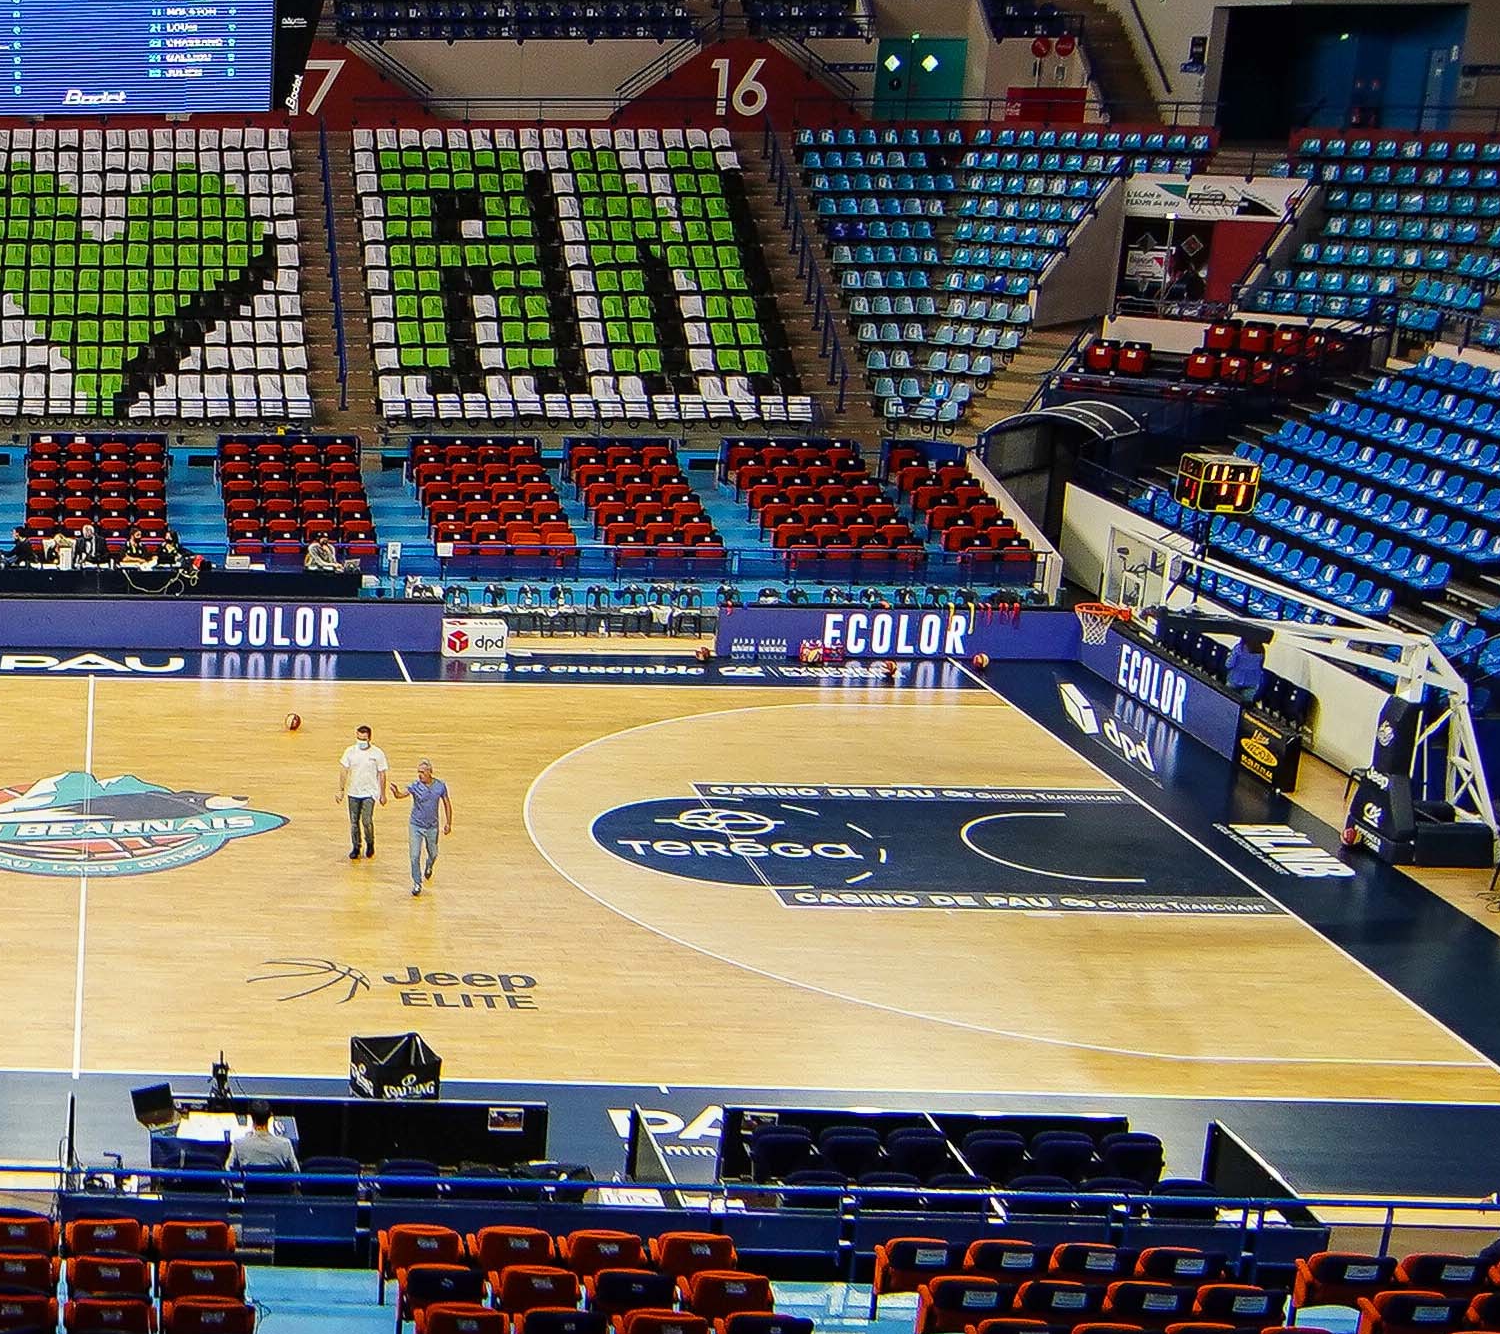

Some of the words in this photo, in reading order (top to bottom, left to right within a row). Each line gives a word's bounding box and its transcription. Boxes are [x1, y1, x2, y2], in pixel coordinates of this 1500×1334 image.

[284, 74, 304, 110] Bodet
[710, 58, 768, 117] 16
[200, 604, 341, 649] ECOLOR
[822, 611, 968, 657] ECOLOR
[474, 633, 505, 653] dpd
[548, 664, 706, 676] ensemble
[1117, 643, 1188, 724] ECOLOR
[1101, 717, 1158, 773] dpd
[1366, 766, 1389, 790] Jeep
[708, 785, 820, 798] CASINO
[827, 786, 873, 799] DE
[876, 787, 936, 799] PAU
[14, 815, 255, 839] BEARNAIS
[794, 892, 919, 906] CASINO
[928, 893, 979, 907] DE
[984, 894, 1051, 908] PAU
[381, 966, 539, 992] Jeep
[399, 988, 540, 1010] ÉLITE
[382, 1080, 436, 1099] SPALDING
[606, 1104, 725, 1140] PA
